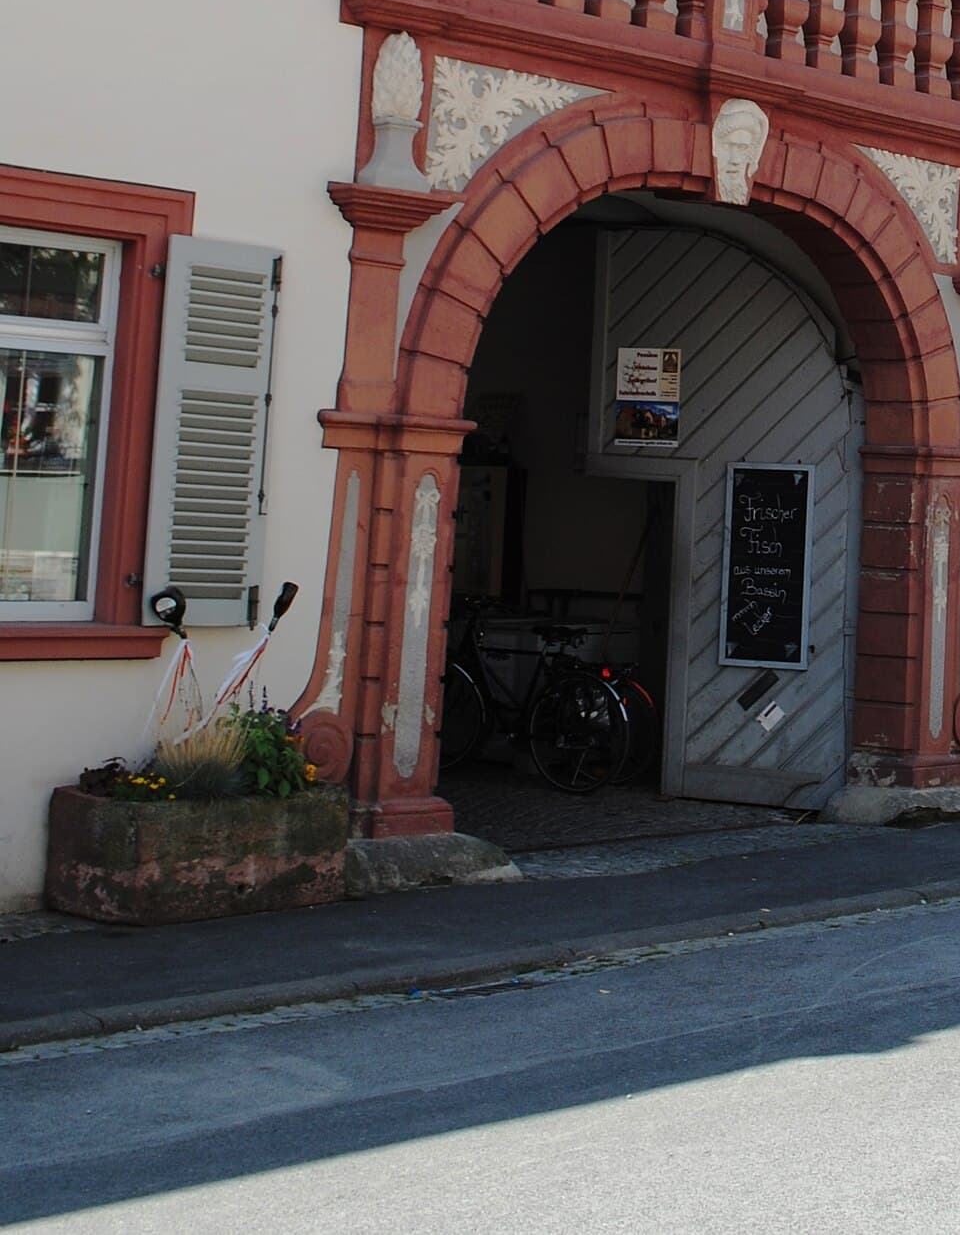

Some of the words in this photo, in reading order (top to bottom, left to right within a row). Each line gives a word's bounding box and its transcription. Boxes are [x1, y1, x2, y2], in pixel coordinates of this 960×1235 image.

[739, 493, 798, 523] Frischer
[739, 526, 784, 557] Fisch
[733, 565, 751, 576] aus
[753, 565, 792, 582] unserem
